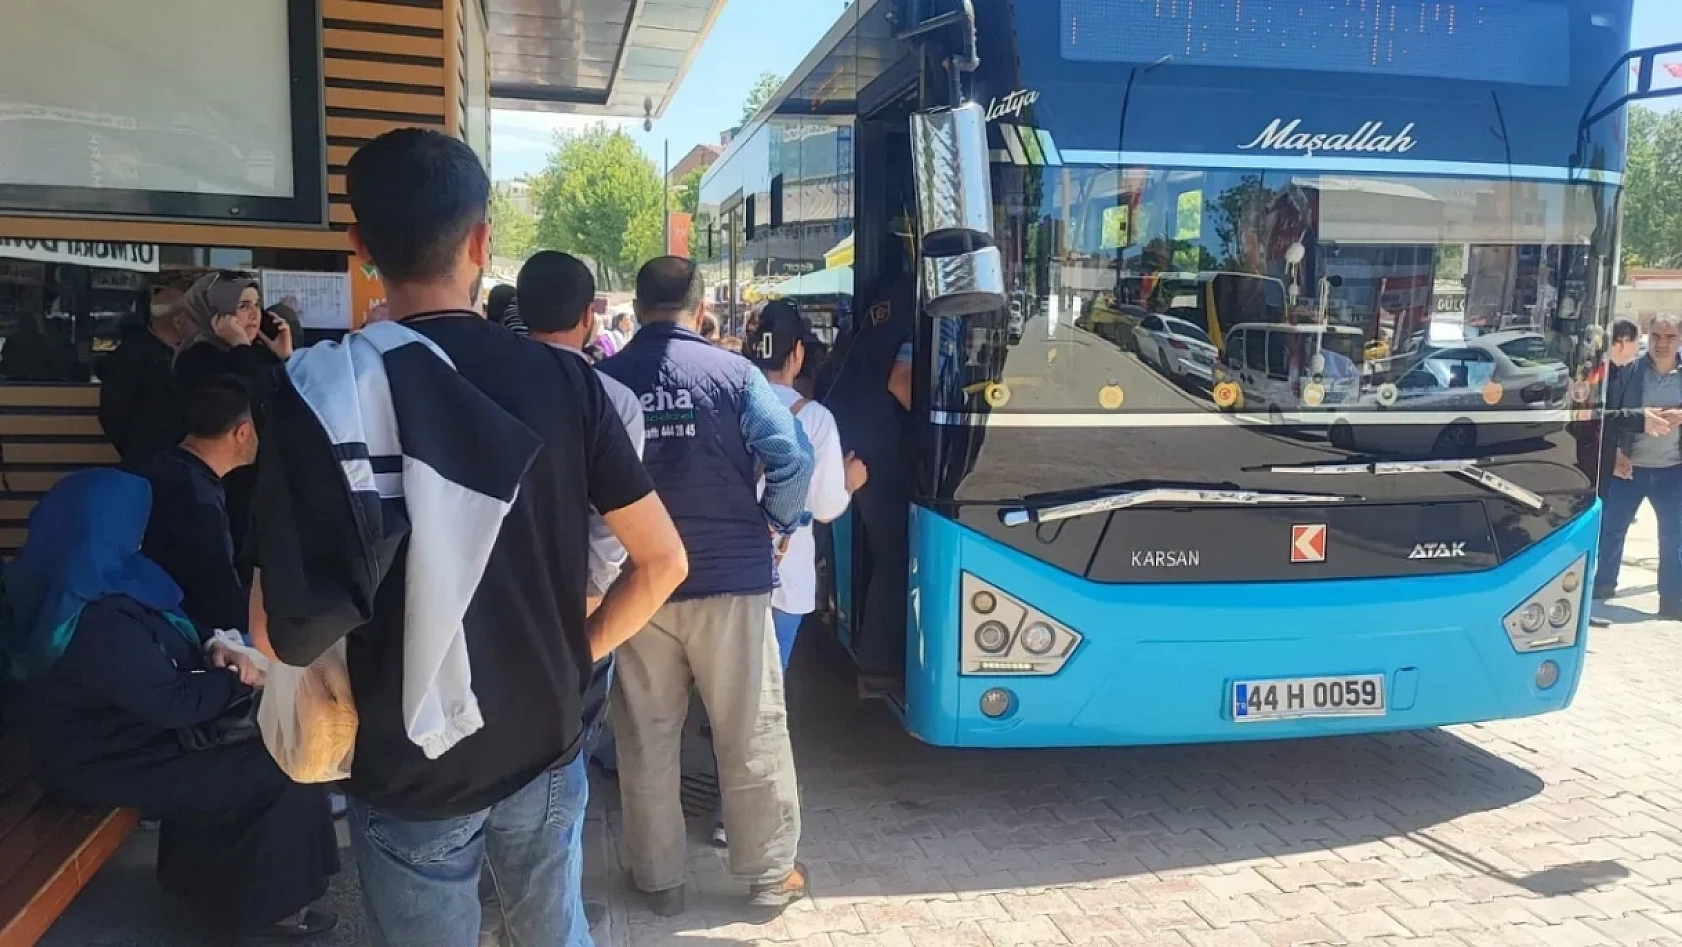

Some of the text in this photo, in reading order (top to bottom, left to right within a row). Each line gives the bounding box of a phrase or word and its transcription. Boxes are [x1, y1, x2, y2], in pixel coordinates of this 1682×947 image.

[985, 89, 1040, 122] latya
[1237, 118, 1418, 157] Maşallah
[640, 385, 694, 412] eha
[1131, 550, 1200, 567] KARSAN
[1408, 541, 1466, 559] ATAK
[1249, 680, 1376, 711] 44 H 0059
